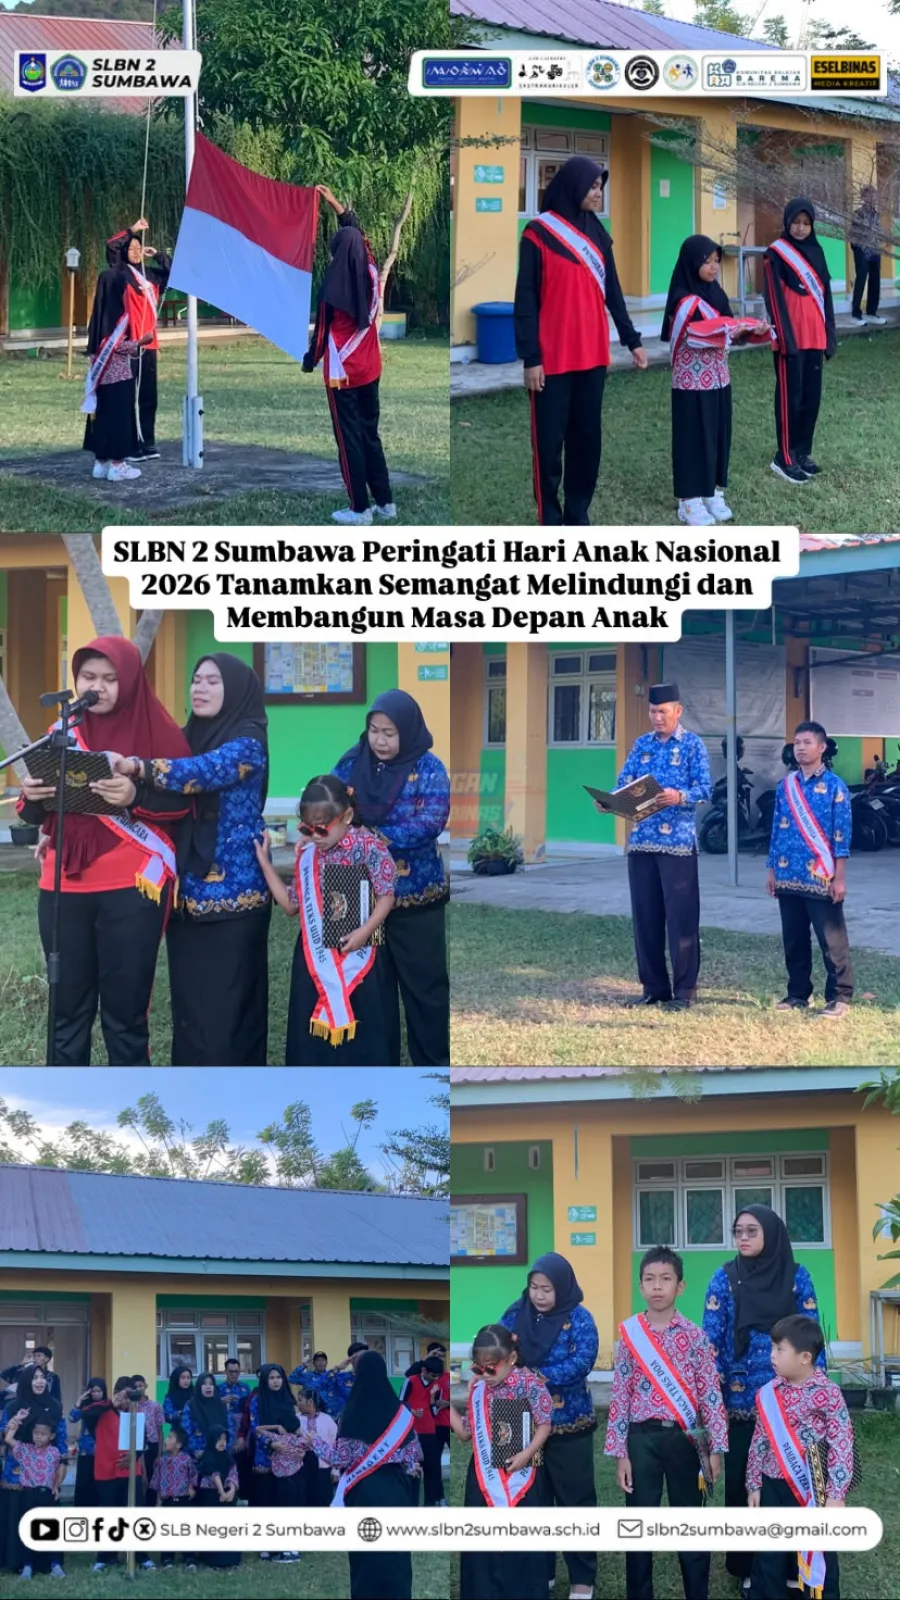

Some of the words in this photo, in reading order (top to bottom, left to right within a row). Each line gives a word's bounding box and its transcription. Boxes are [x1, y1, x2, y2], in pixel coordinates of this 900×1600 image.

[304, 903, 316, 926] TEKS
[310, 923, 322, 946] UUD
[314, 945, 328, 964] 1945
[650, 1359, 666, 1378] DOA
[661, 1375, 679, 1398] TEKS
[673, 1396, 697, 1429] EMBACA
[782, 1441, 802, 1479] PEMBACA
[485, 1464, 496, 1482] 1945
